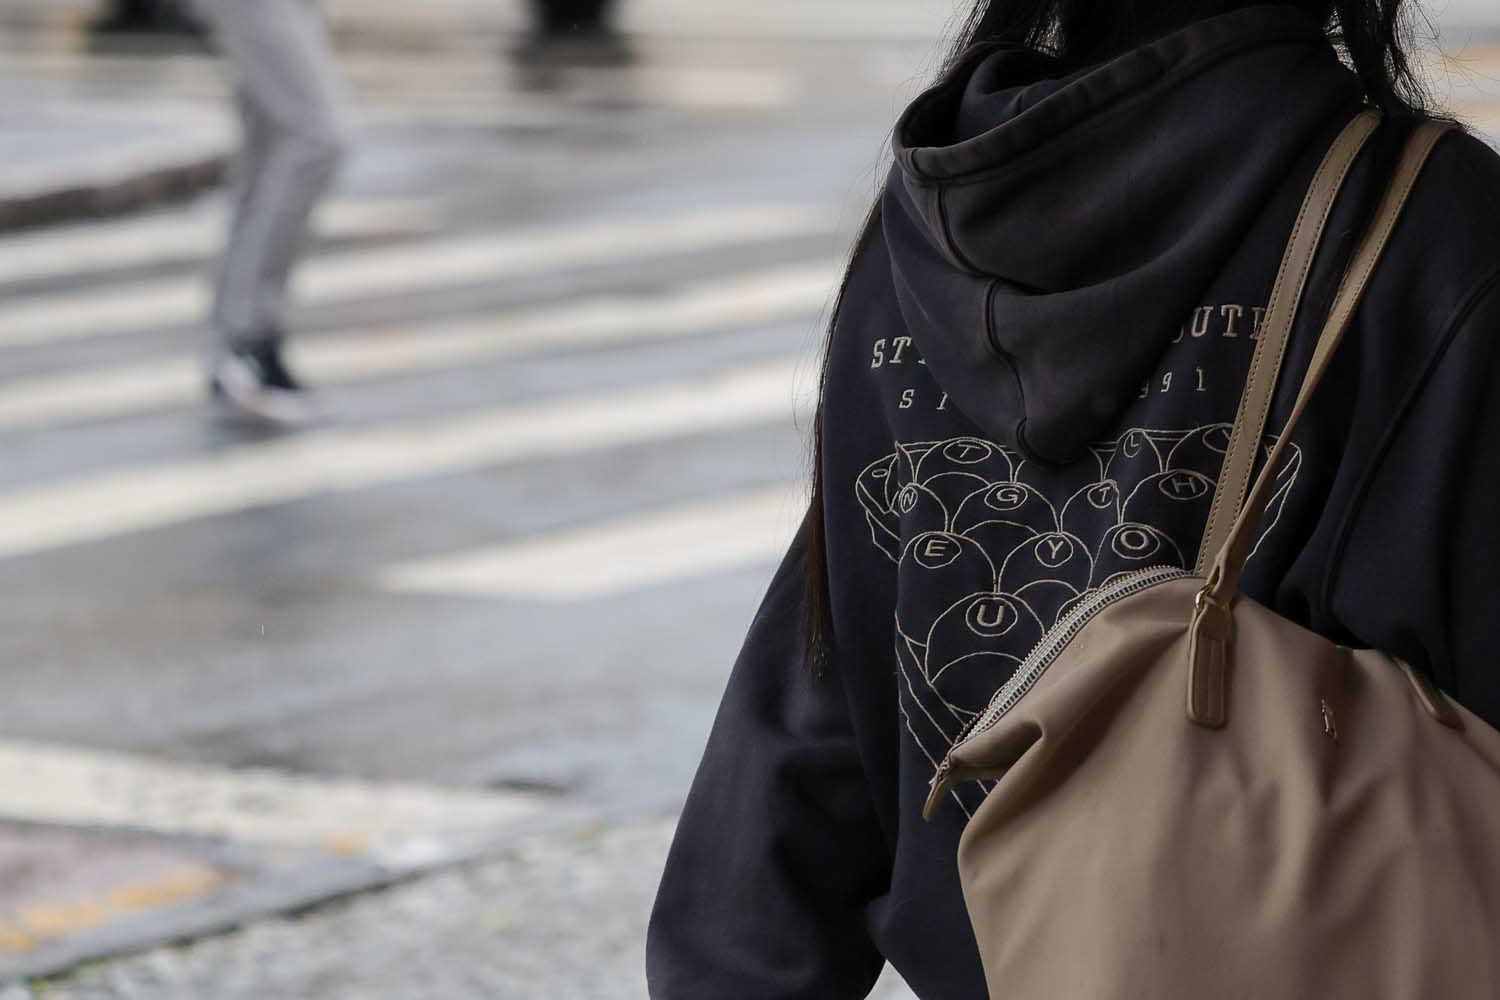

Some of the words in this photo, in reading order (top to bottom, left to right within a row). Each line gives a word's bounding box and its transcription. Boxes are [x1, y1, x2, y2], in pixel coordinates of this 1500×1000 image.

[870, 335, 927, 369] ST
[995, 488, 1021, 504] G
[1169, 476, 1198, 495] H
[923, 539, 950, 557] E
[1046, 539, 1065, 560] Y
[976, 603, 1005, 628] U
